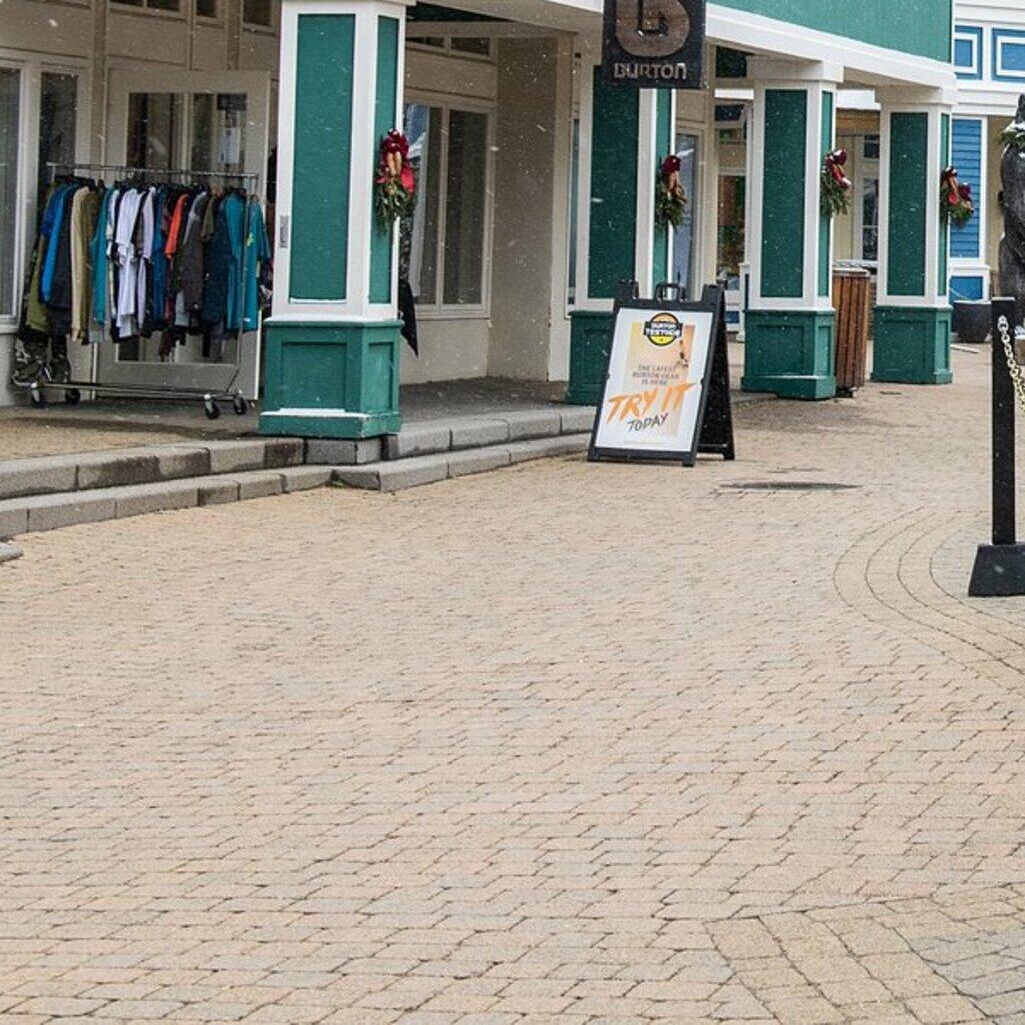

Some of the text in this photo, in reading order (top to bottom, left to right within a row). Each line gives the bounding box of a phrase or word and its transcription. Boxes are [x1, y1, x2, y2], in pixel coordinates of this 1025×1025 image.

[614, 62, 688, 80] BURTON
[607, 381, 697, 424] TRY IT
[627, 413, 669, 432] TODAY
